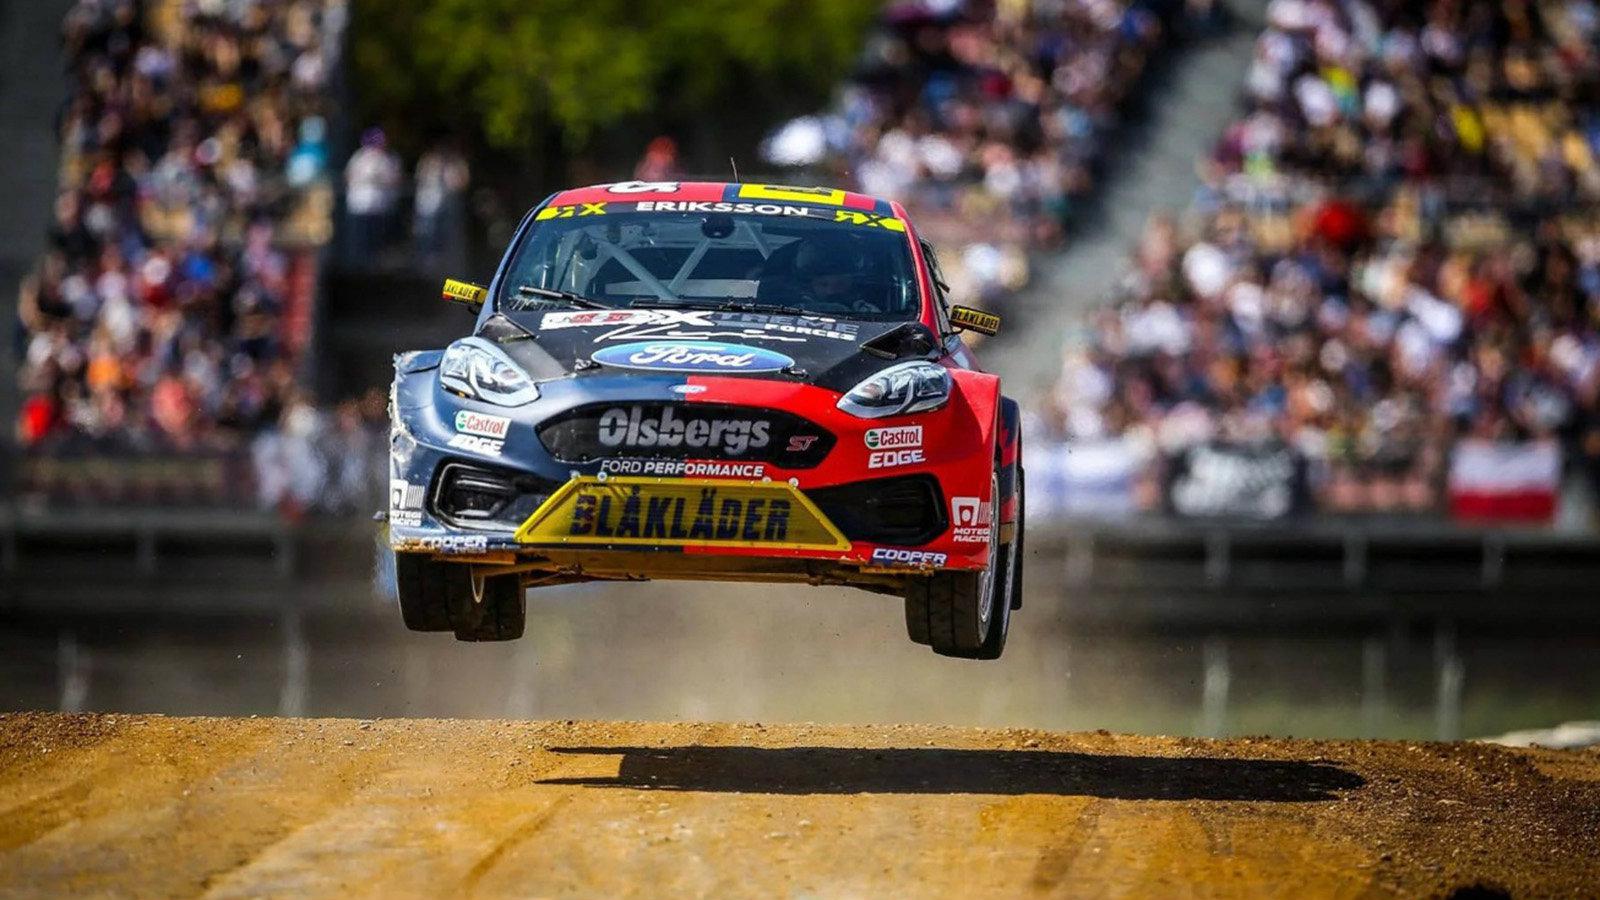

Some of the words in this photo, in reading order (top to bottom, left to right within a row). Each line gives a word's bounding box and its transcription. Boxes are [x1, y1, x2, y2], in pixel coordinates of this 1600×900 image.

[636, 201, 808, 216] ERIKSSON
[764, 323, 856, 341] FORCES
[629, 345, 757, 367] Ford
[466, 414, 505, 434] Castrol
[599, 405, 770, 454] Olsbergs
[786, 436, 818, 451] ST
[880, 429, 919, 446] Castrol
[868, 449, 927, 469] EDGE
[600, 460, 641, 473] FORD
[643, 462, 764, 477] PERFORMANCE
[569, 485, 791, 541] BLÅKLÄDER
[953, 527, 992, 535] MOTEG
[872, 548, 947, 564] COOPER
